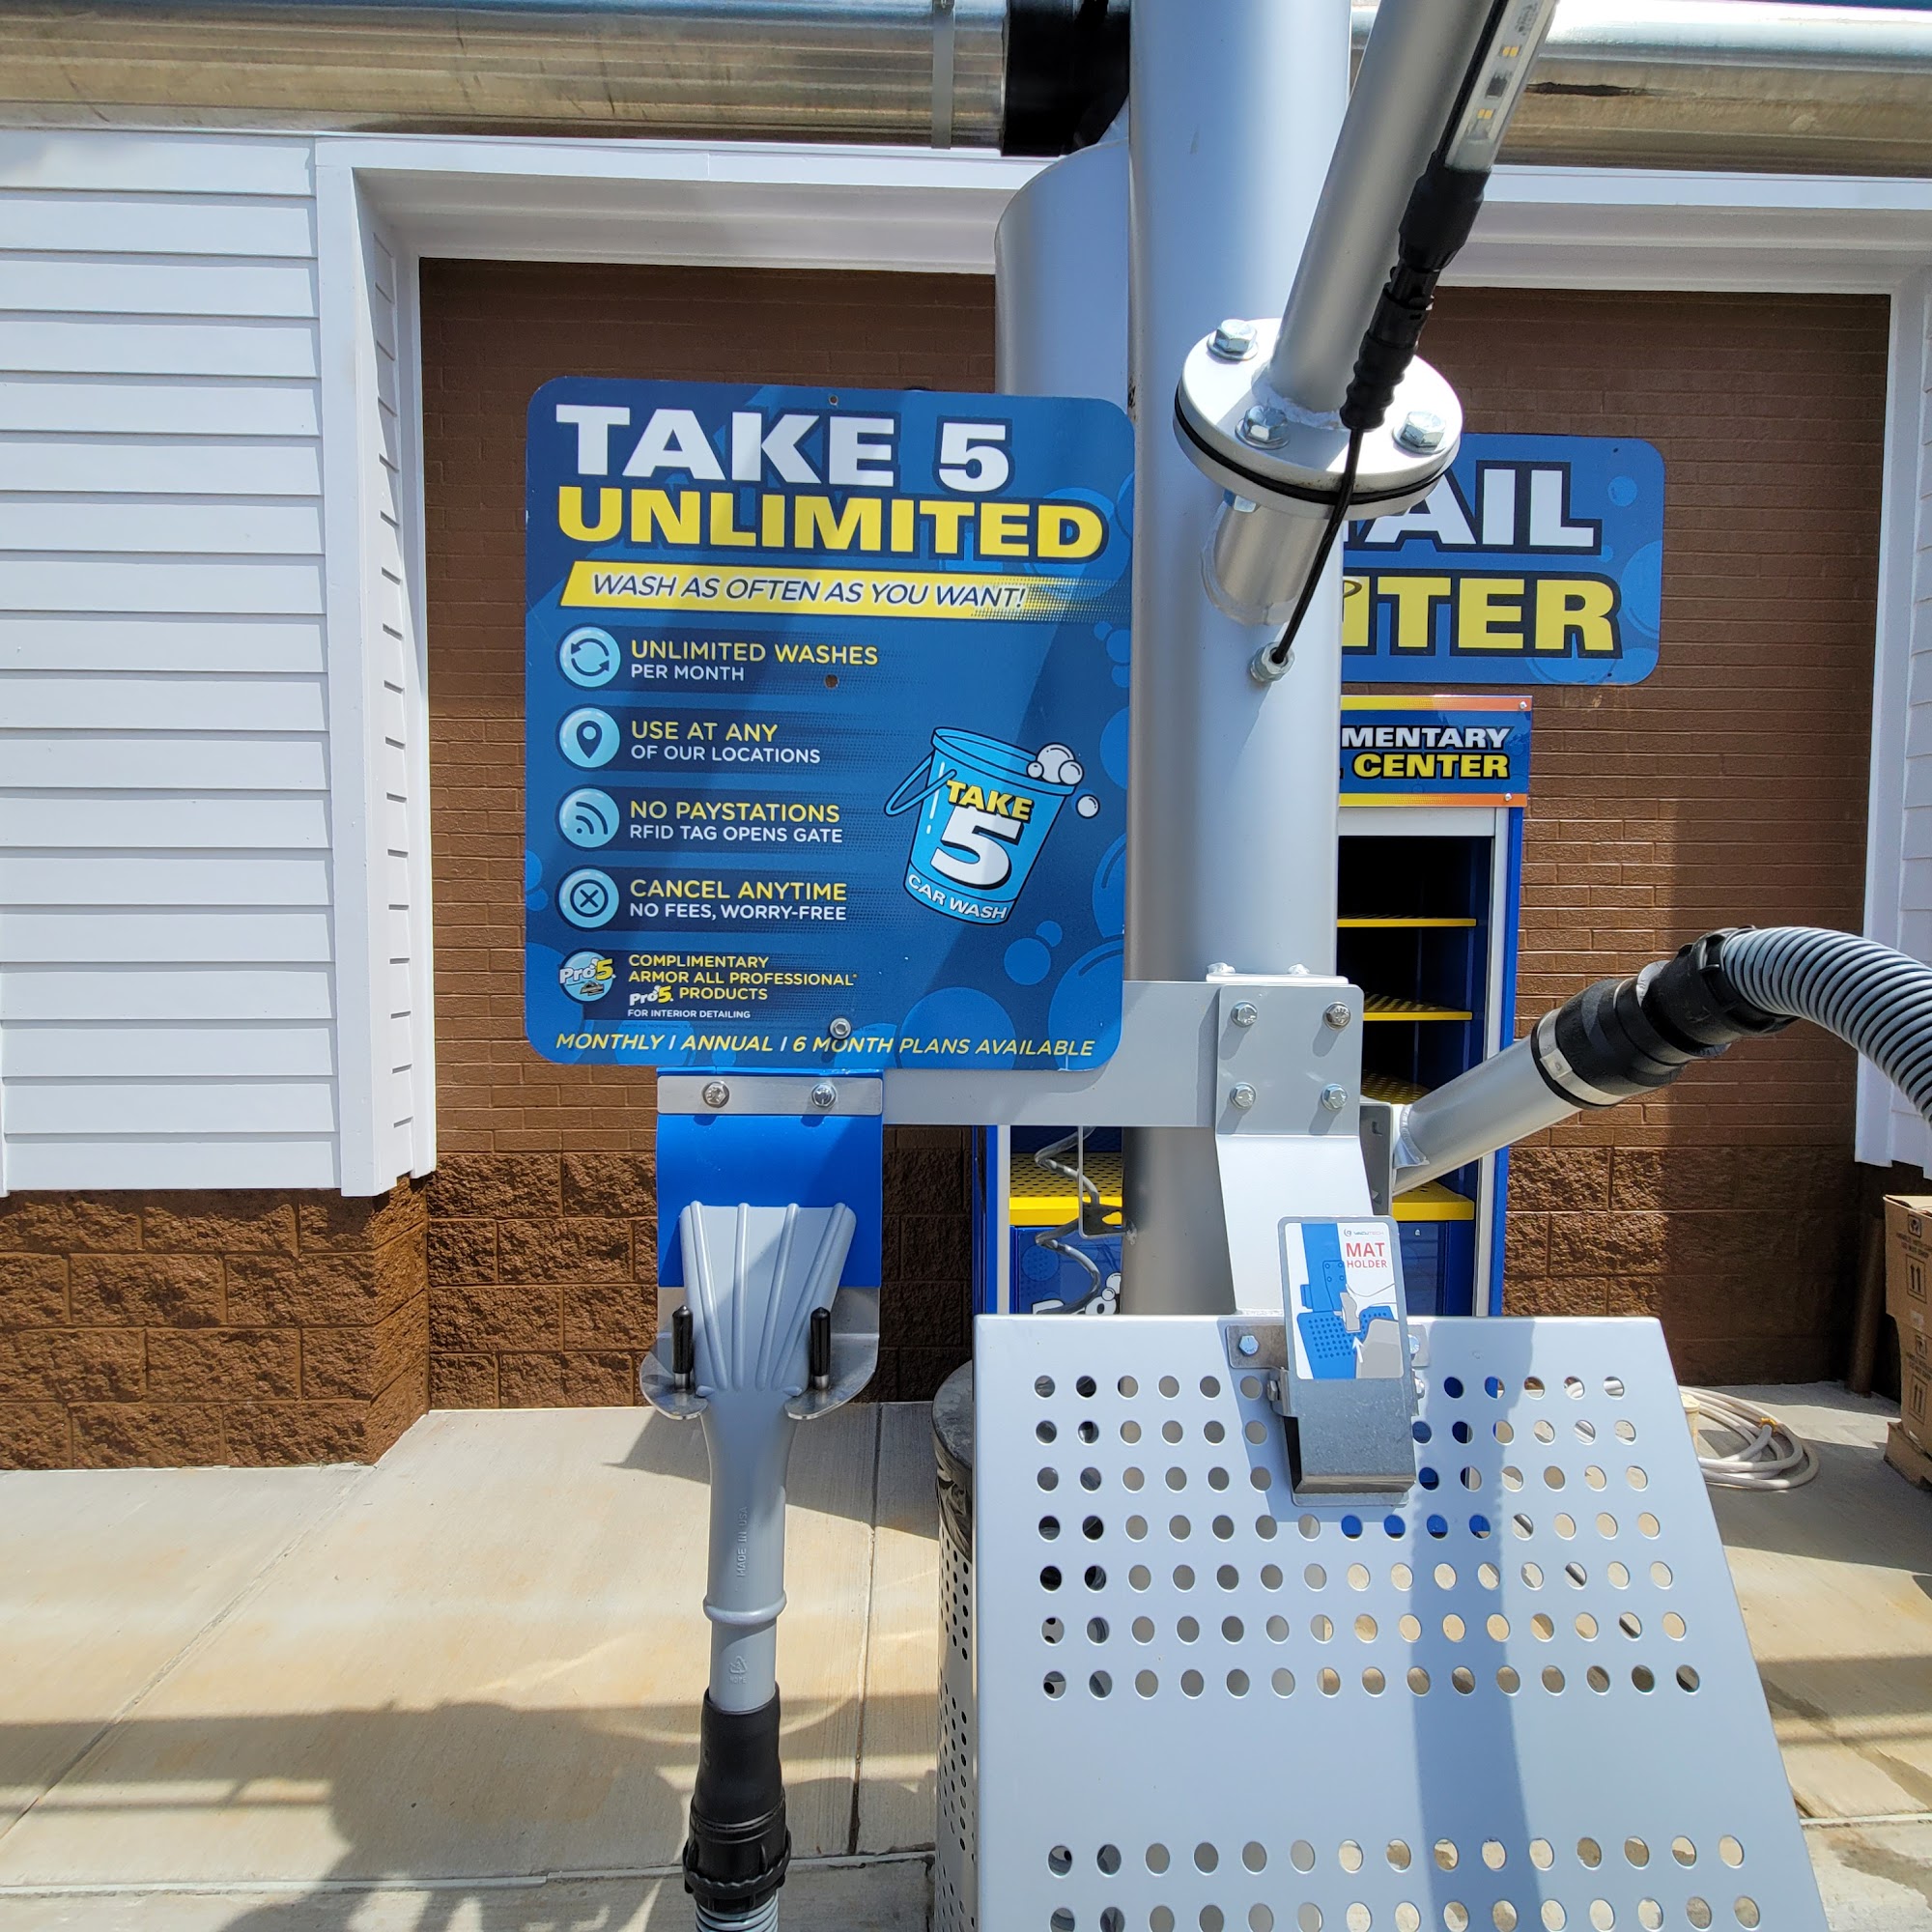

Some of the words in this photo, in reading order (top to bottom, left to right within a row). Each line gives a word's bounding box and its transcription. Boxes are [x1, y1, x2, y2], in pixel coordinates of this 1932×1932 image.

[555, 404, 895, 488] TAKE
[938, 421, 1009, 493] 5
[1344, 468, 1594, 547] AIL
[558, 486, 1103, 558] UNLIMITED
[593, 574, 676, 597] WASH
[681, 577, 721, 599] AS
[725, 579, 820, 602] OFTEN
[825, 582, 863, 603] AS
[871, 583, 929, 606] YOU
[936, 585, 1027, 610] WANT!
[631, 639, 766, 662] UNLIMITED
[775, 644, 878, 666] WASHES
[631, 664, 668, 679] PER
[673, 665, 745, 681] MONTH
[631, 721, 679, 740] USE
[687, 722, 718, 741] AT
[725, 723, 779, 742] ANY
[631, 745, 658, 760] OF
[664, 746, 705, 761] OUR
[711, 747, 821, 764] LOCATIONS
[1353, 753, 1509, 778] CENTER
[630, 800, 668, 819] NO
[675, 801, 840, 823] PAYSTATIONS
[947, 779, 1034, 823] TAKE
[630, 825, 674, 840] RFID
[679, 825, 718, 840] TAG
[723, 827, 788, 842] OPENS
[793, 828, 843, 843] GATE
[929, 806, 1022, 891] 5
[630, 879, 730, 898] CANCEL
[737, 881, 848, 901] ANYTIME
[907, 873, 946, 907] CAR
[949, 895, 1009, 920] WASH
[630, 902, 659, 918] NO
[665, 903, 717, 921] FEES,
[721, 904, 847, 922] WORRY-FREE
[628, 953, 769, 969] COMPLIMENTARY
[628, 970, 689, 983] ARMOR
[694, 972, 724, 984] ALL
[679, 986, 768, 1001] PRODUCTS
[628, 1009, 648, 1018] FOR
[650, 1009, 696, 1019] INTERIOR
[698, 1009, 751, 1019] DETAILING
[555, 1033, 666, 1050] MONTHLY
[680, 1036, 773, 1052] ANNUAL
[793, 1036, 808, 1053] 6
[812, 1037, 895, 1054] MONTH
[898, 1037, 970, 1055] PLANS
[975, 1039, 1095, 1057] AVAILABLE
[1346, 1242, 1385, 1258] MAT
[1347, 1259, 1387, 1268] HOLDER
